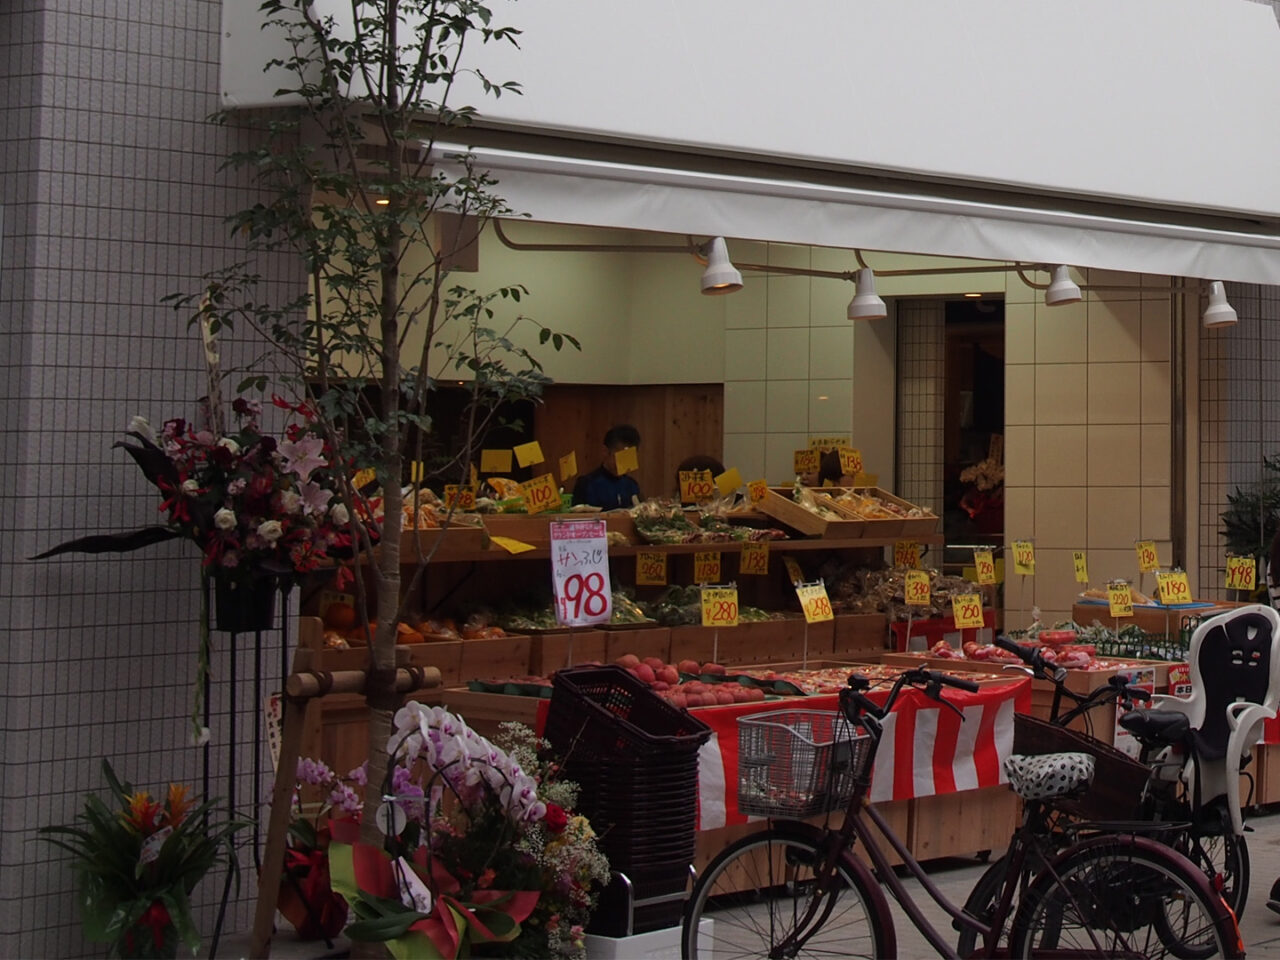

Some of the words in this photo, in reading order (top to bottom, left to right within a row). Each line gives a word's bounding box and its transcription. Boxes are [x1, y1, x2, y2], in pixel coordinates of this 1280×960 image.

[531, 485, 552, 505] 100
[687, 482, 712, 496] 100
[1165, 581, 1187, 596] 180
[1112, 593, 1130, 606] 220
